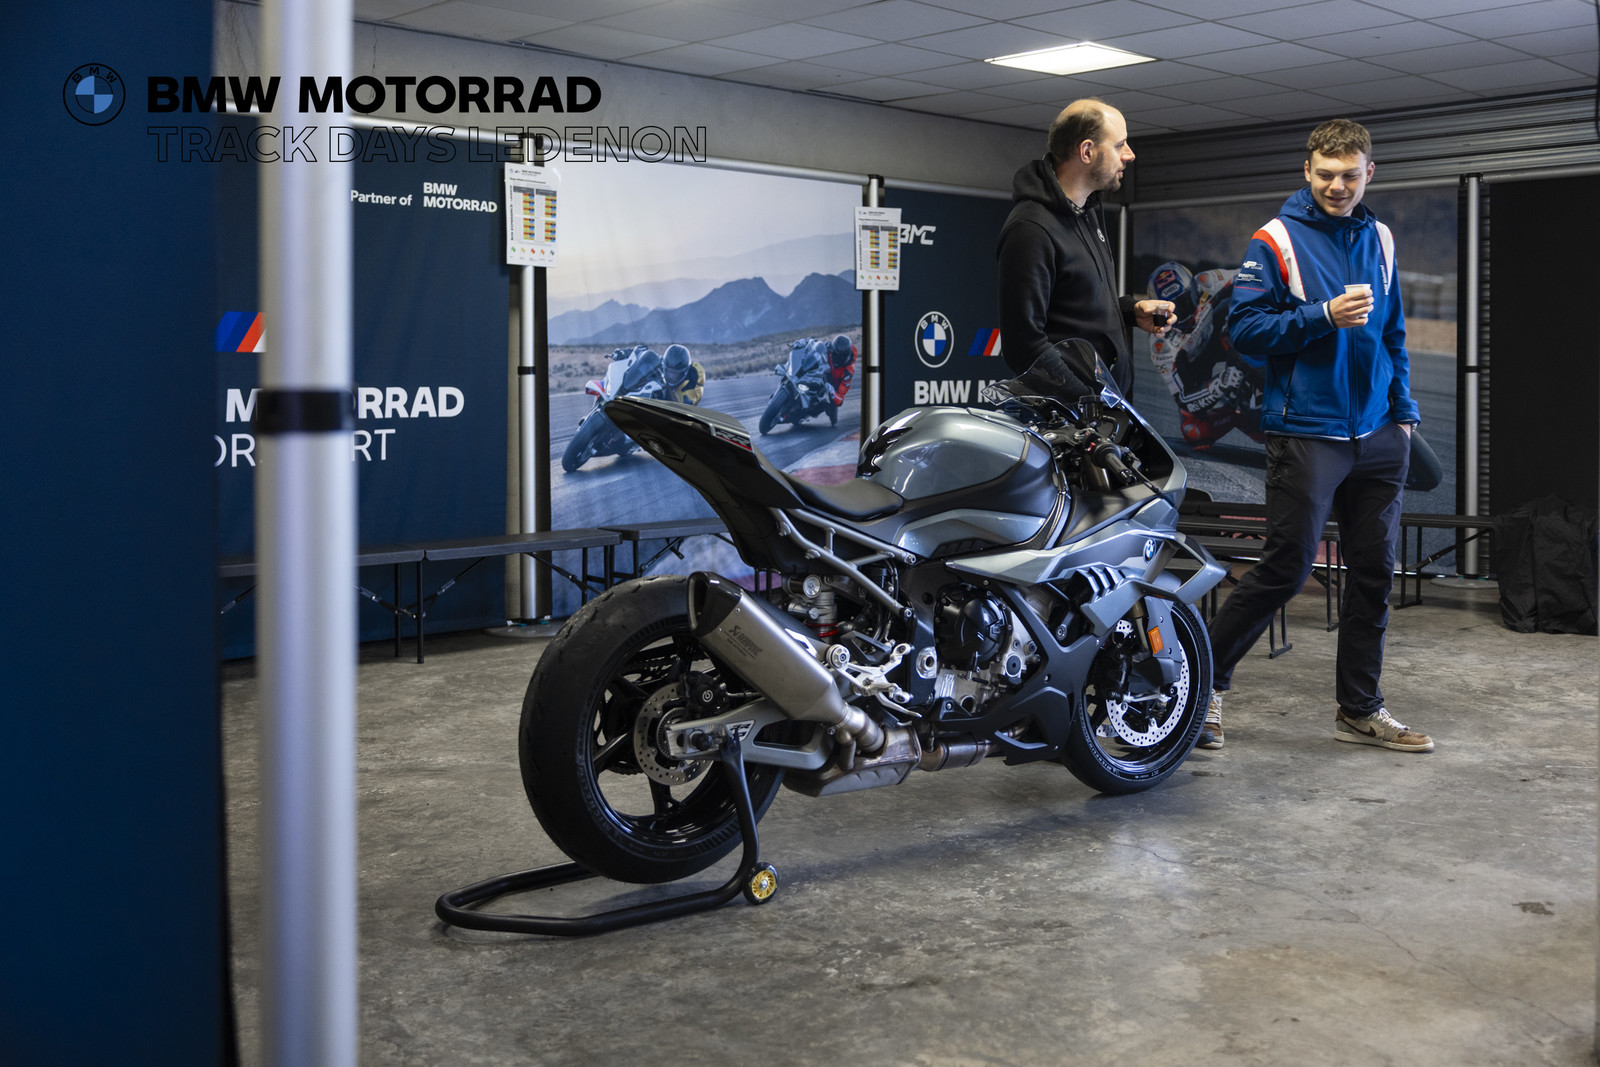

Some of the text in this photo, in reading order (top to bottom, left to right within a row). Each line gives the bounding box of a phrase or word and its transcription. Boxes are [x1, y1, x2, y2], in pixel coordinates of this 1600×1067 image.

[423, 182, 458, 196] BMW
[350, 190, 412, 206] Partner of
[423, 196, 498, 213] MOTORRAD
[920, 314, 949, 330] BMW
[914, 380, 971, 405] BMW
